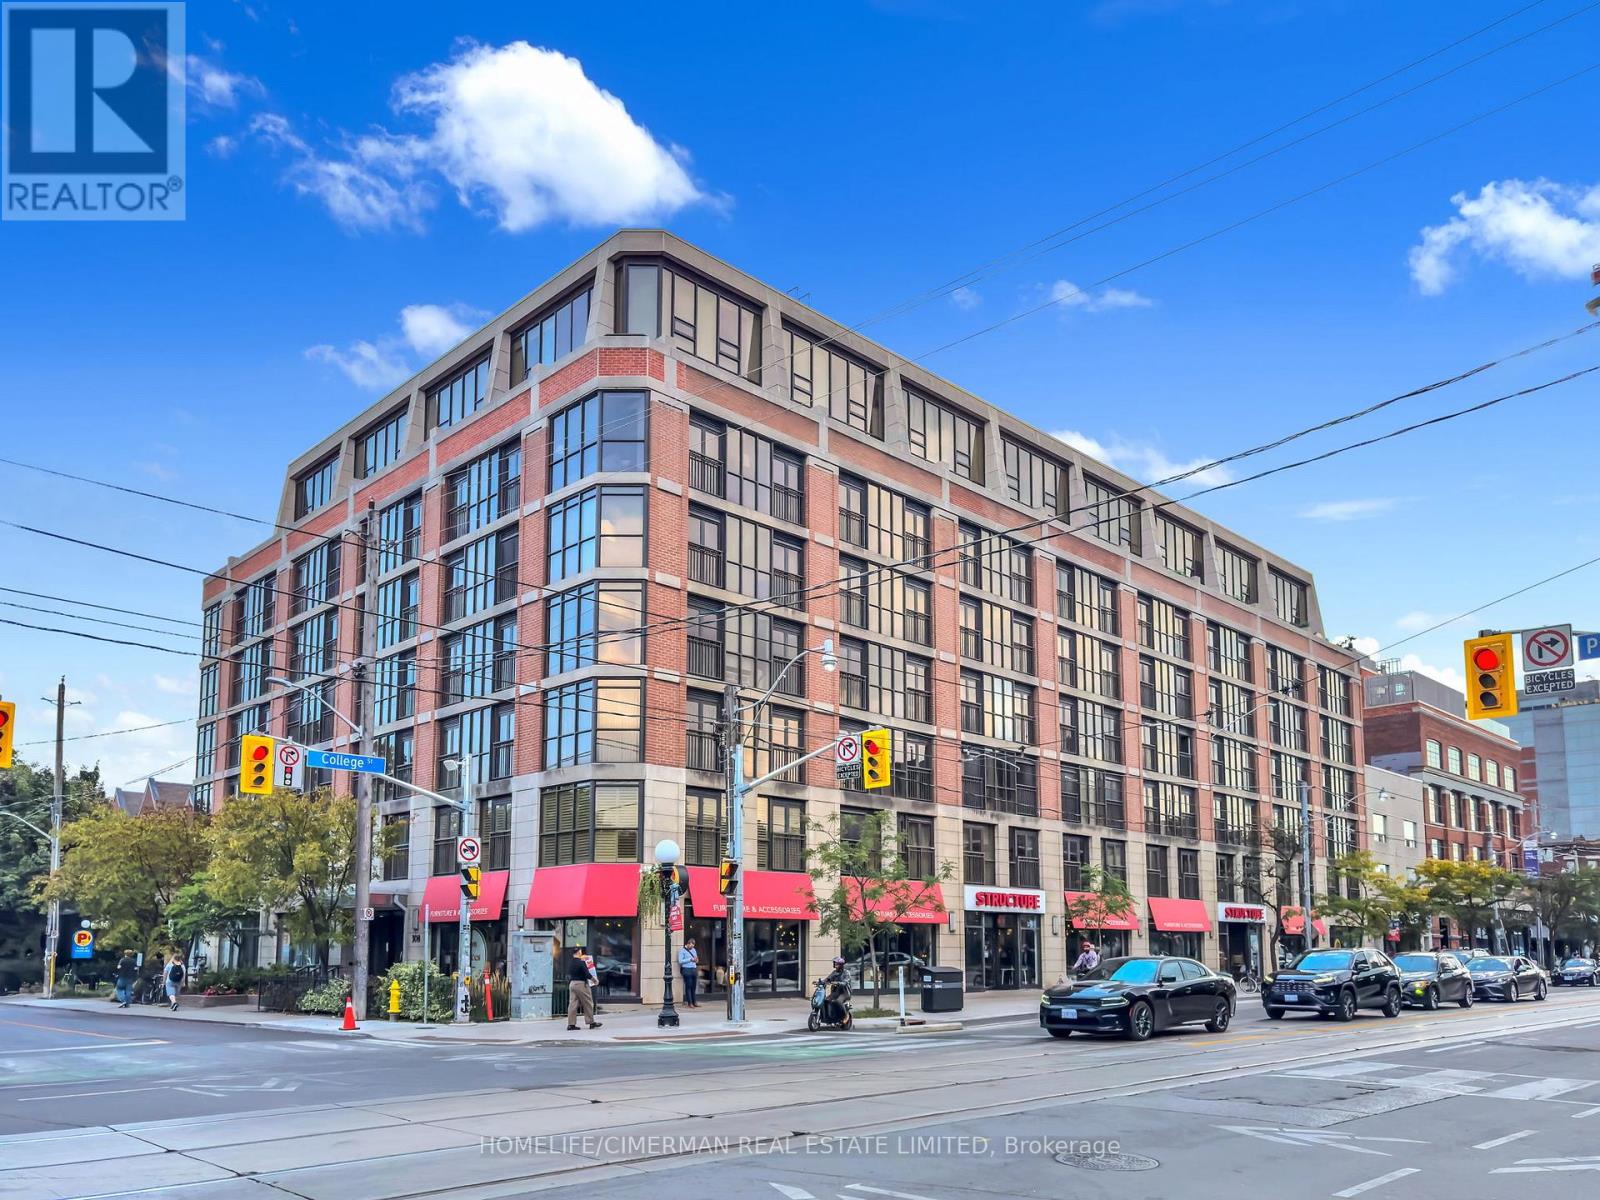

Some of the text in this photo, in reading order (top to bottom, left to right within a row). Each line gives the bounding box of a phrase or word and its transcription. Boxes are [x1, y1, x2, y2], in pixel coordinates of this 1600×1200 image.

[1525, 671, 1574, 683] BICYCLES
[1526, 681, 1574, 694] EXCEPTED
[321, 753, 365, 770] College
[975, 892, 1041, 909] STRUCTUBE
[758, 905, 802, 915] ACCESSORIES
